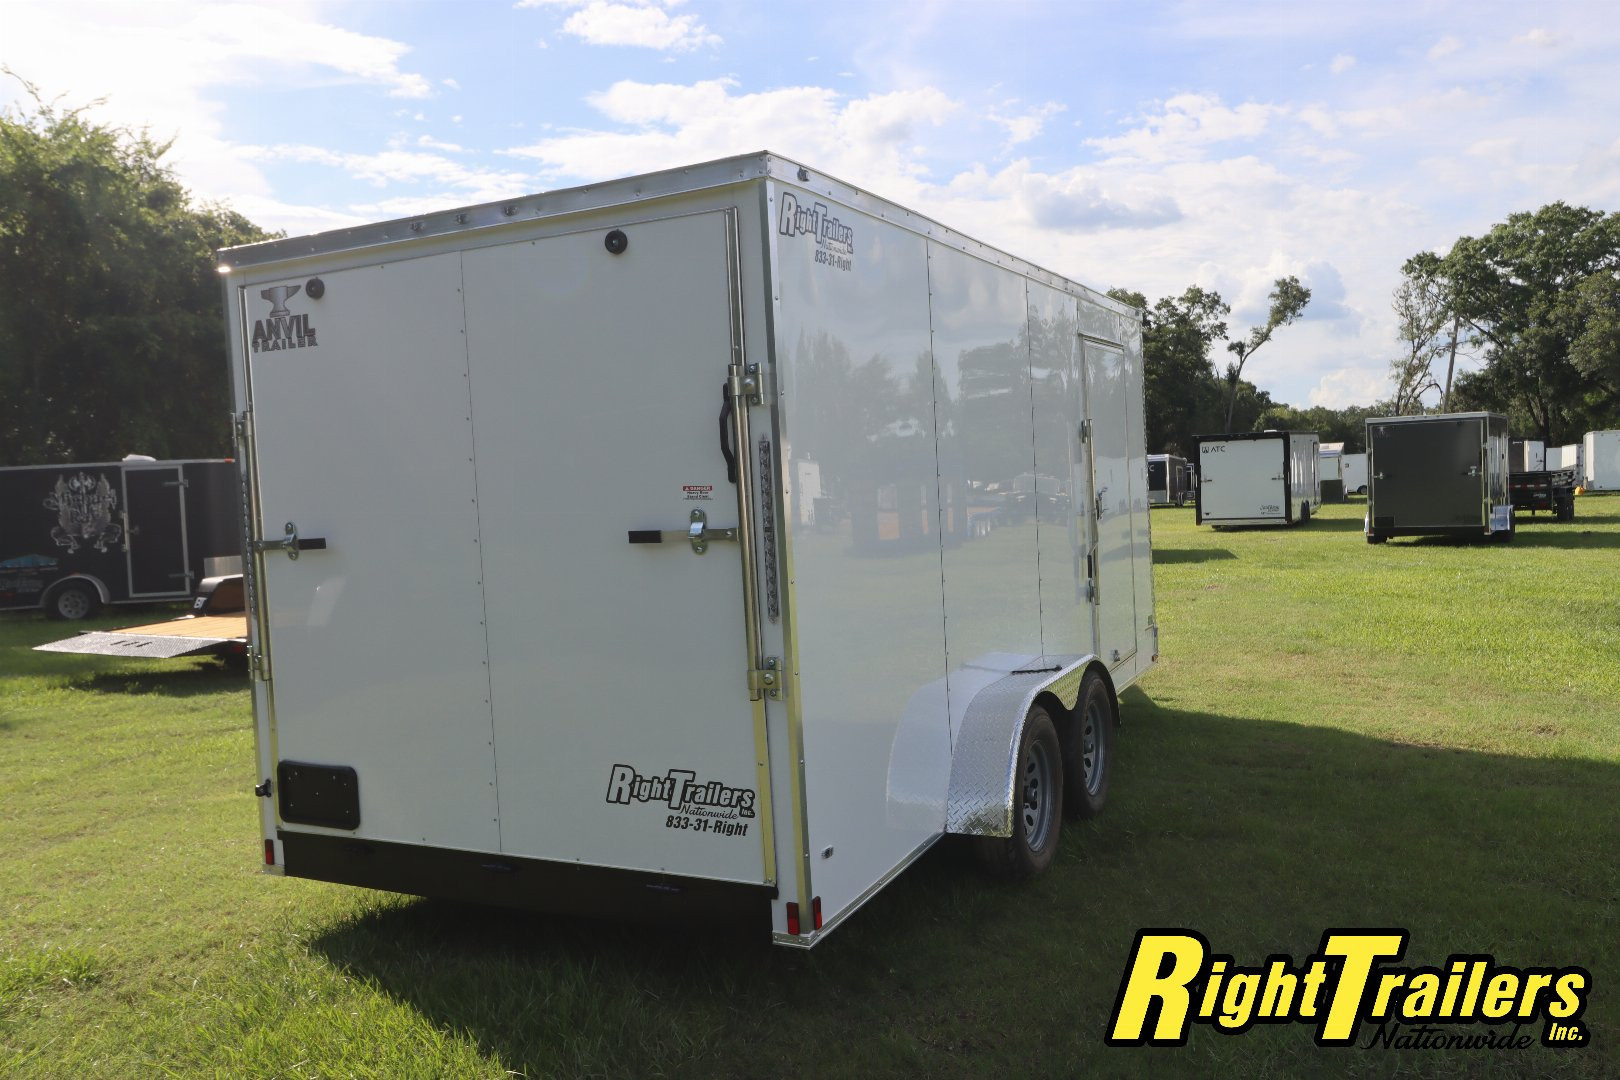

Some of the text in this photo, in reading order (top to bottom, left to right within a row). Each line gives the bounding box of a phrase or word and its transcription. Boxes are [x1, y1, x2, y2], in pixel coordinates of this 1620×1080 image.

[252, 314, 316, 347] ANVIL
[680, 804, 738, 819] Nationwide
[666, 815, 748, 836] 833-31-Right
